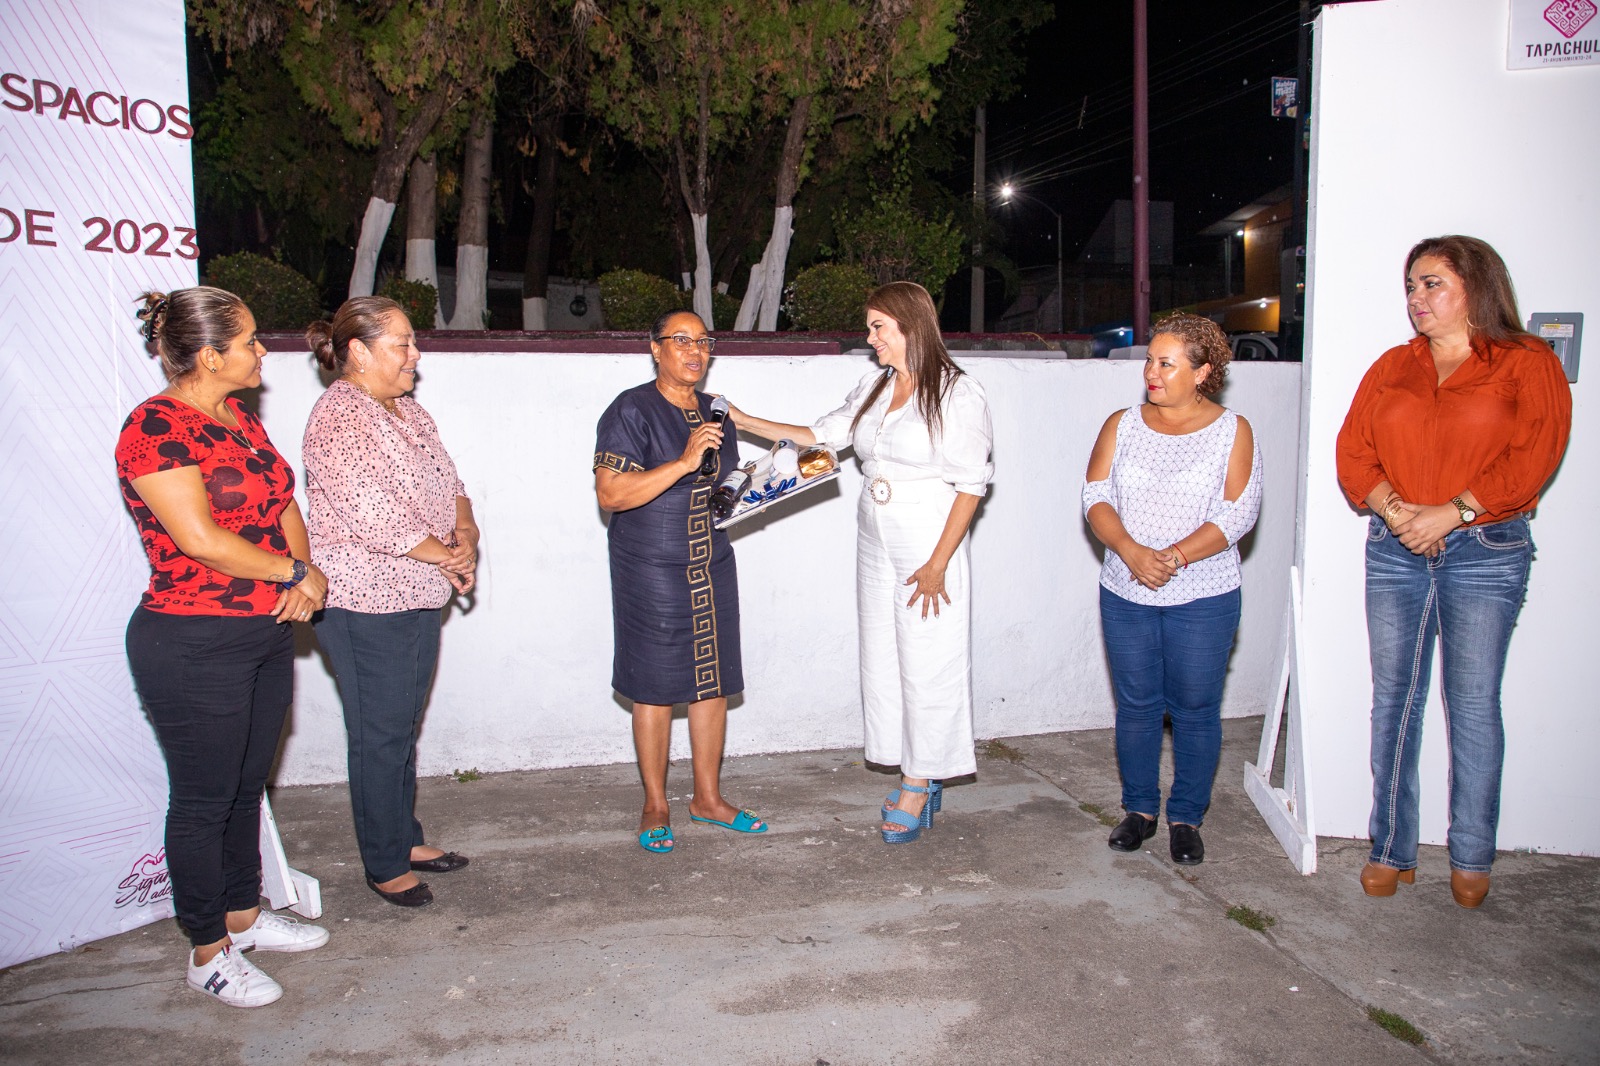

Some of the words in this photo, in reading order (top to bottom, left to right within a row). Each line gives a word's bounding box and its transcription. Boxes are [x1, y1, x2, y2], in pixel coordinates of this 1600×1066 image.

[1526, 39, 1600, 58] TAPACHUL
[0, 72, 194, 140] SPACIOS
[0, 207, 57, 247] DE
[83, 216, 201, 260] 2023
